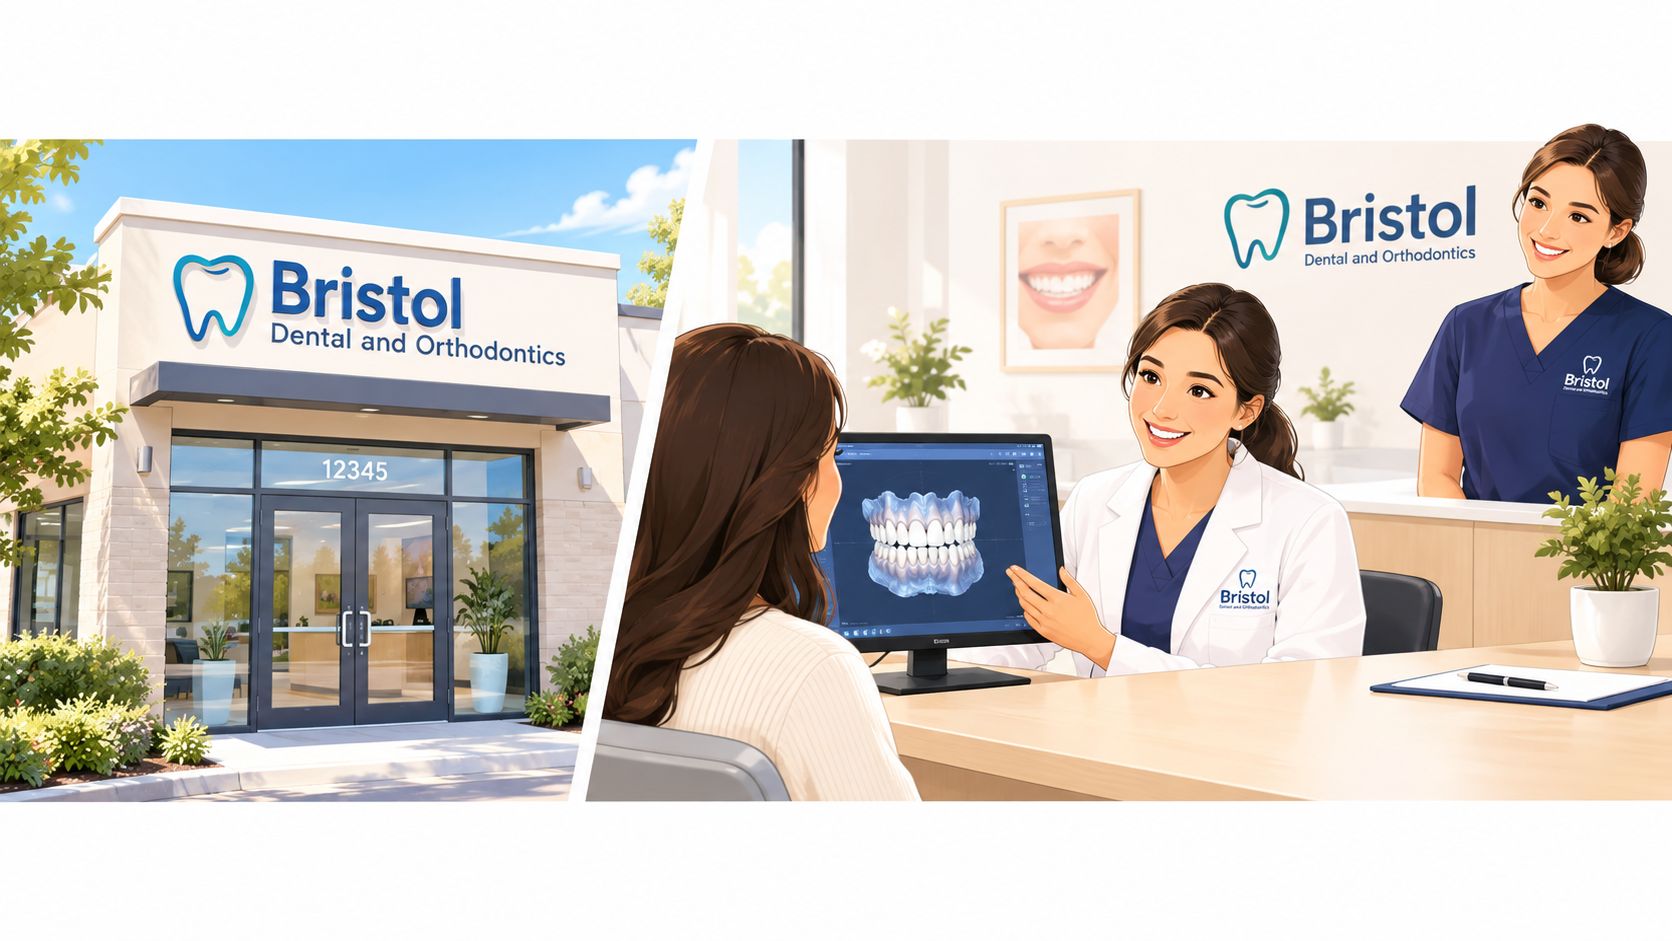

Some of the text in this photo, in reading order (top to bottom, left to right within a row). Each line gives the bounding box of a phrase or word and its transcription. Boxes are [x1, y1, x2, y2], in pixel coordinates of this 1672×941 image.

[1305, 184, 1476, 245] Bristol
[1305, 246, 1476, 266] Dental and Orthodontics
[272, 259, 461, 329] Bristol
[271, 322, 566, 366] Dental and Orthodontics
[1564, 373, 1610, 390] Bristol
[322, 459, 388, 481] 12345
[1220, 590, 1270, 604] Bristol
